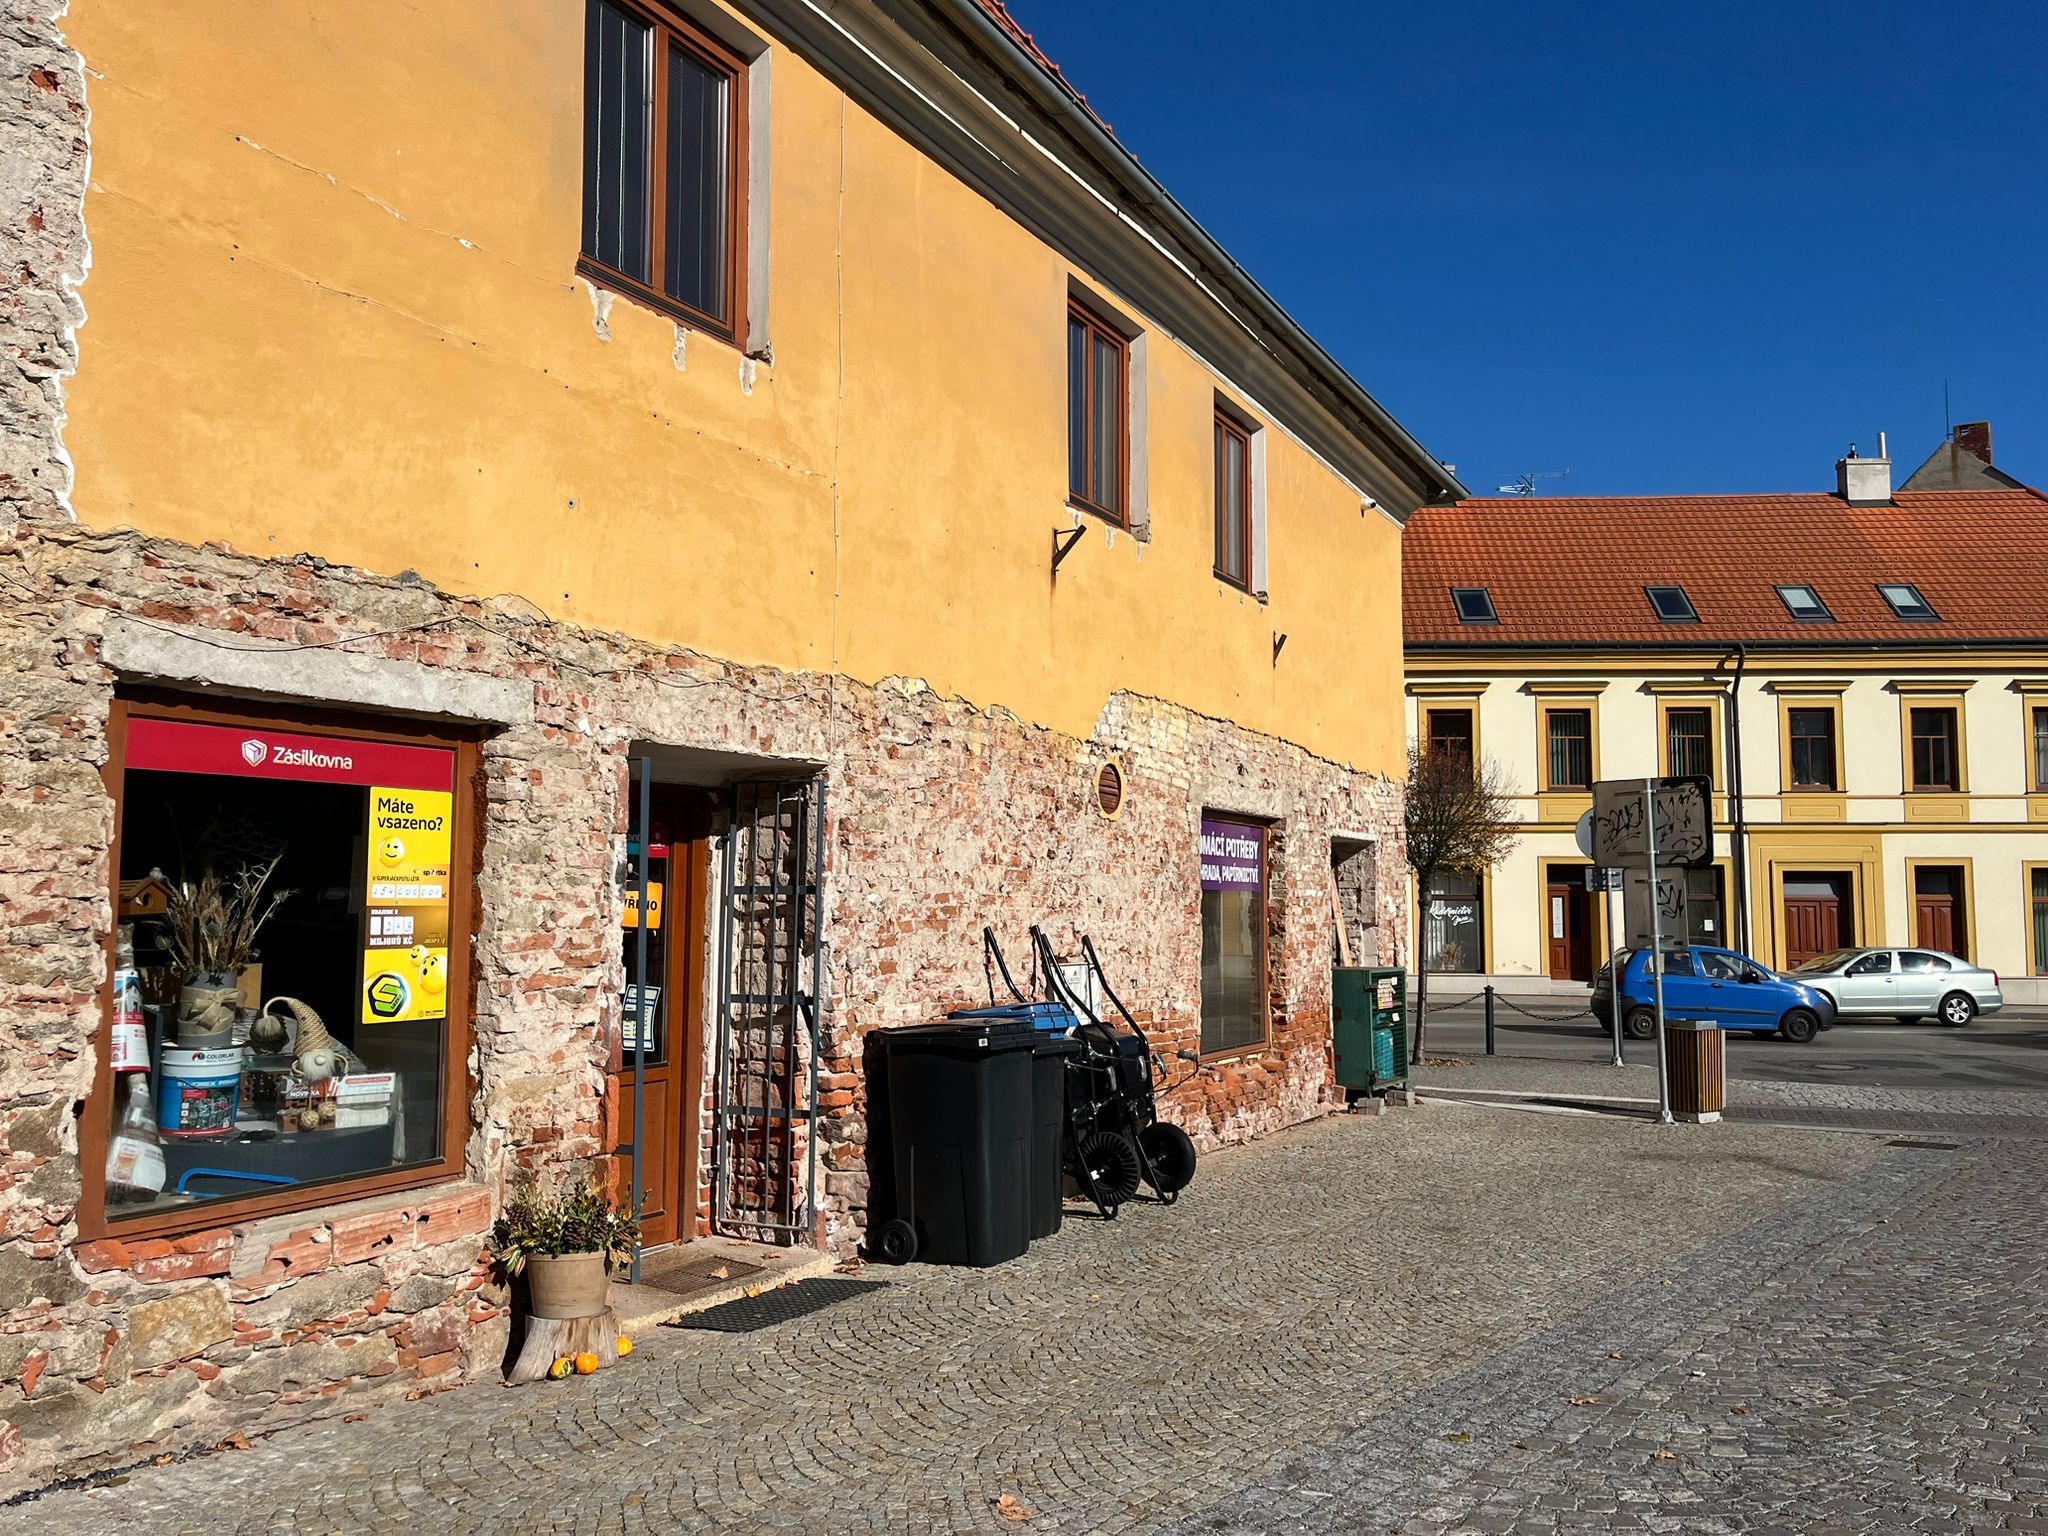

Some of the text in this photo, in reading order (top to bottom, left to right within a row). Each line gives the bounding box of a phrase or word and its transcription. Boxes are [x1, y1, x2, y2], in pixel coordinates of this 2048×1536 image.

[273, 746, 353, 770] Zásilkovna
[378, 797, 414, 814] Máte
[377, 816, 443, 831] vsazeno?
[1226, 835, 1259, 860] POTŘEBY
[1222, 862, 1259, 883] PAPÍRNICTVÍ
